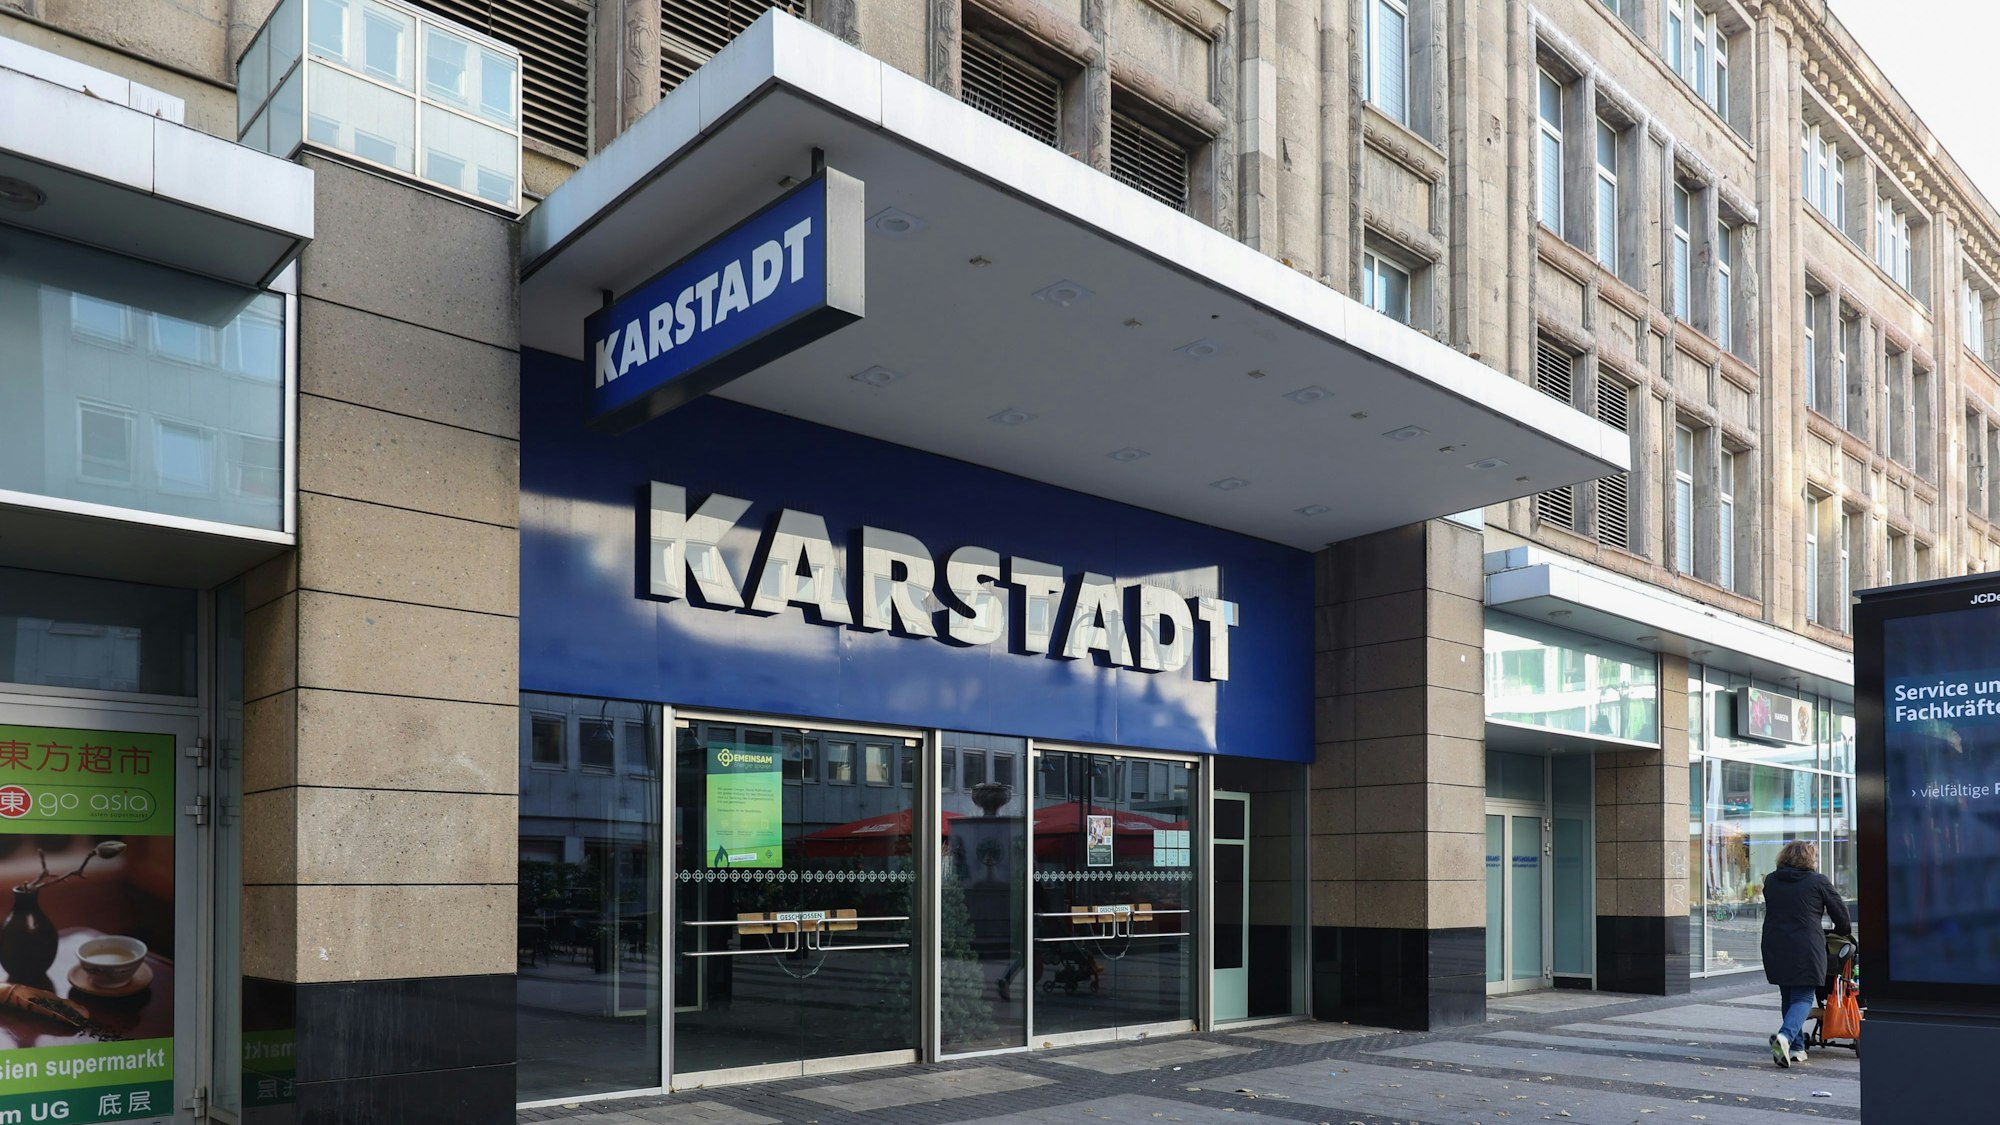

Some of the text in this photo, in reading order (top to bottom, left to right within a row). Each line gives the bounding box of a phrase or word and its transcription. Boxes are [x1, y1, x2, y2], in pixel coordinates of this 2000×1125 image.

[596, 217, 811, 389] KARSTADT
[642, 480, 1239, 681] KARSTADT
[1895, 680, 2000, 701] Service un
[0, 739, 152, 775] 東方超市
[0, 791, 25, 812] 東
[38, 790, 148, 817] go asia
[1920, 784, 1989, 799] vielfältige
[0, 1048, 164, 1081] ien supermarkt
[31, 1101, 69, 1121] UG
[98, 1091, 151, 1116] 底层
